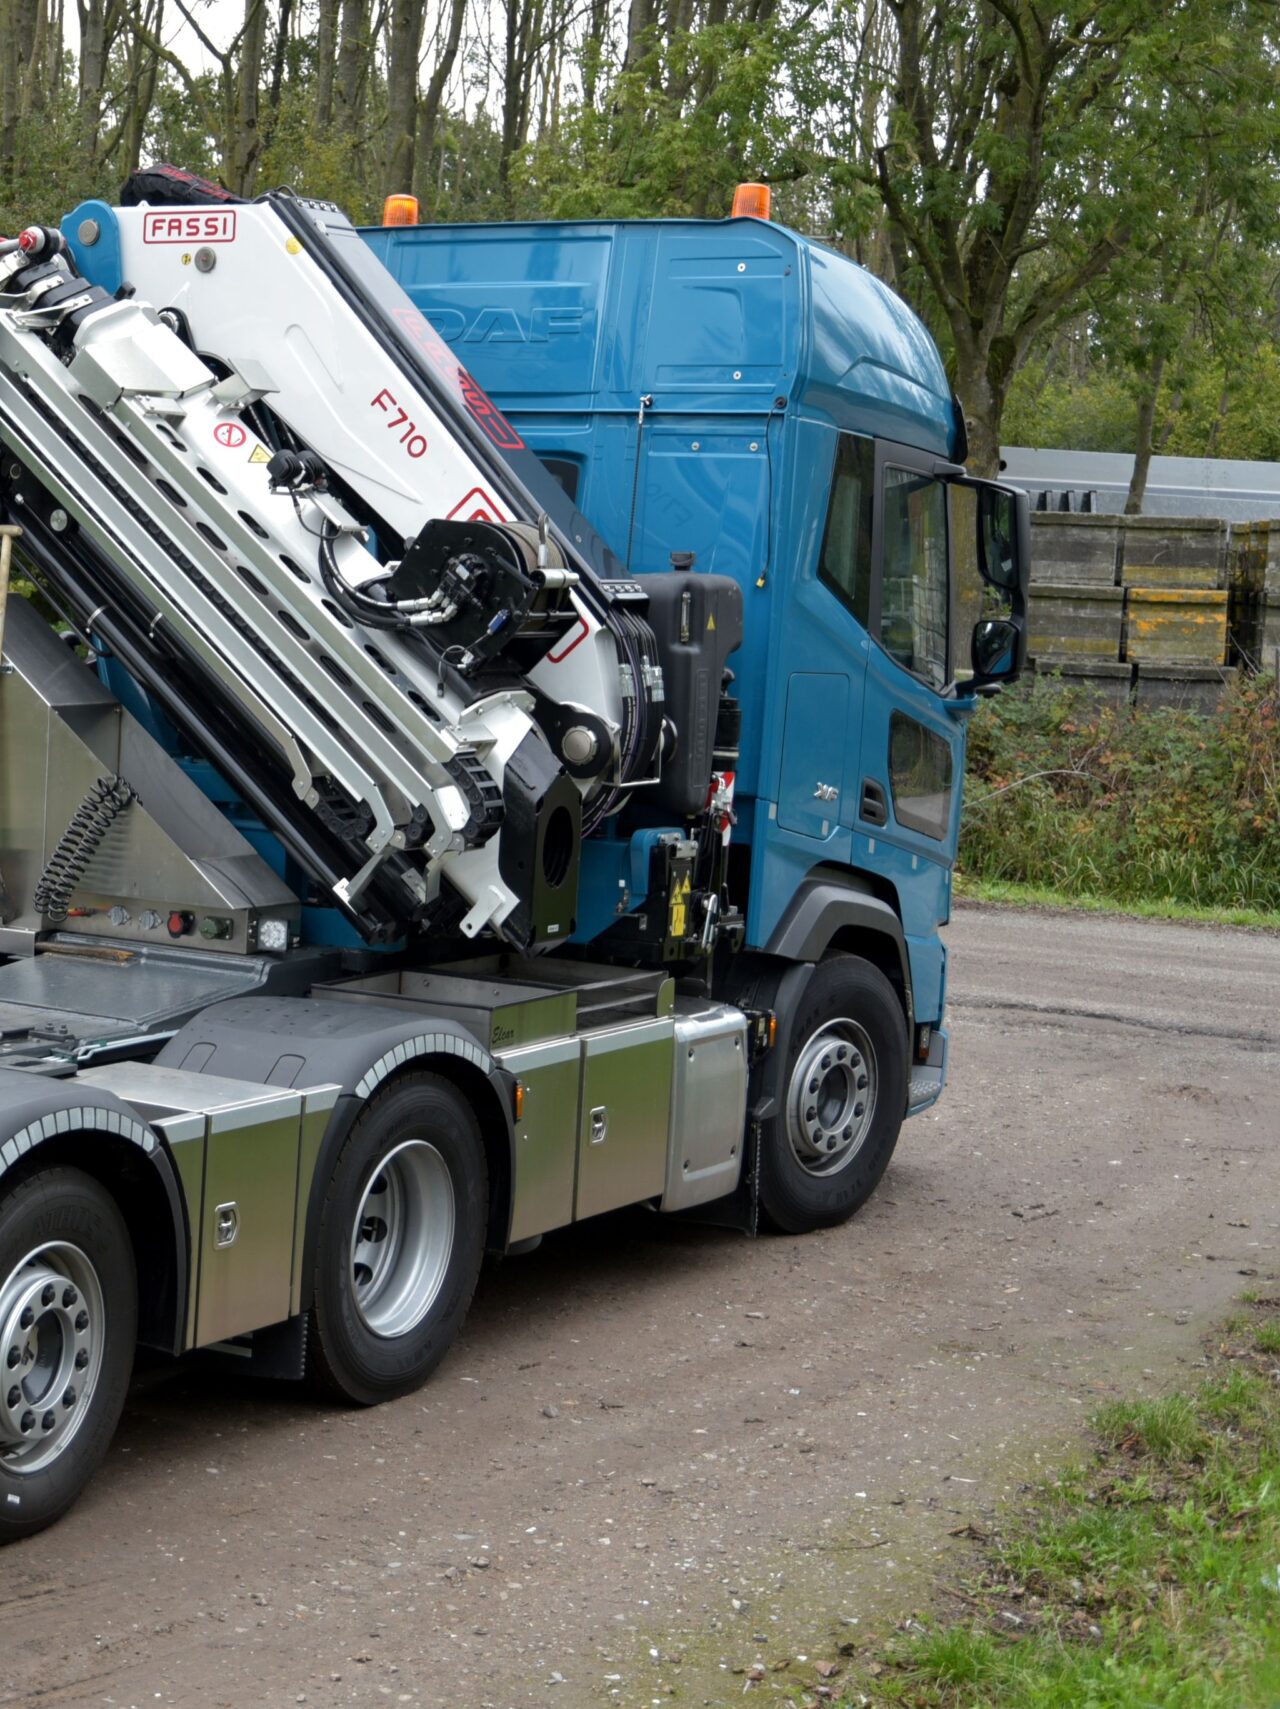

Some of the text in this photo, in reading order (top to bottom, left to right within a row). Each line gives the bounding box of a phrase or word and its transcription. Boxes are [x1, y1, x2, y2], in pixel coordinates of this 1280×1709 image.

[151, 216, 228, 237] FASSI
[420, 307, 584, 343] DAF
[370, 388, 428, 459] F710
